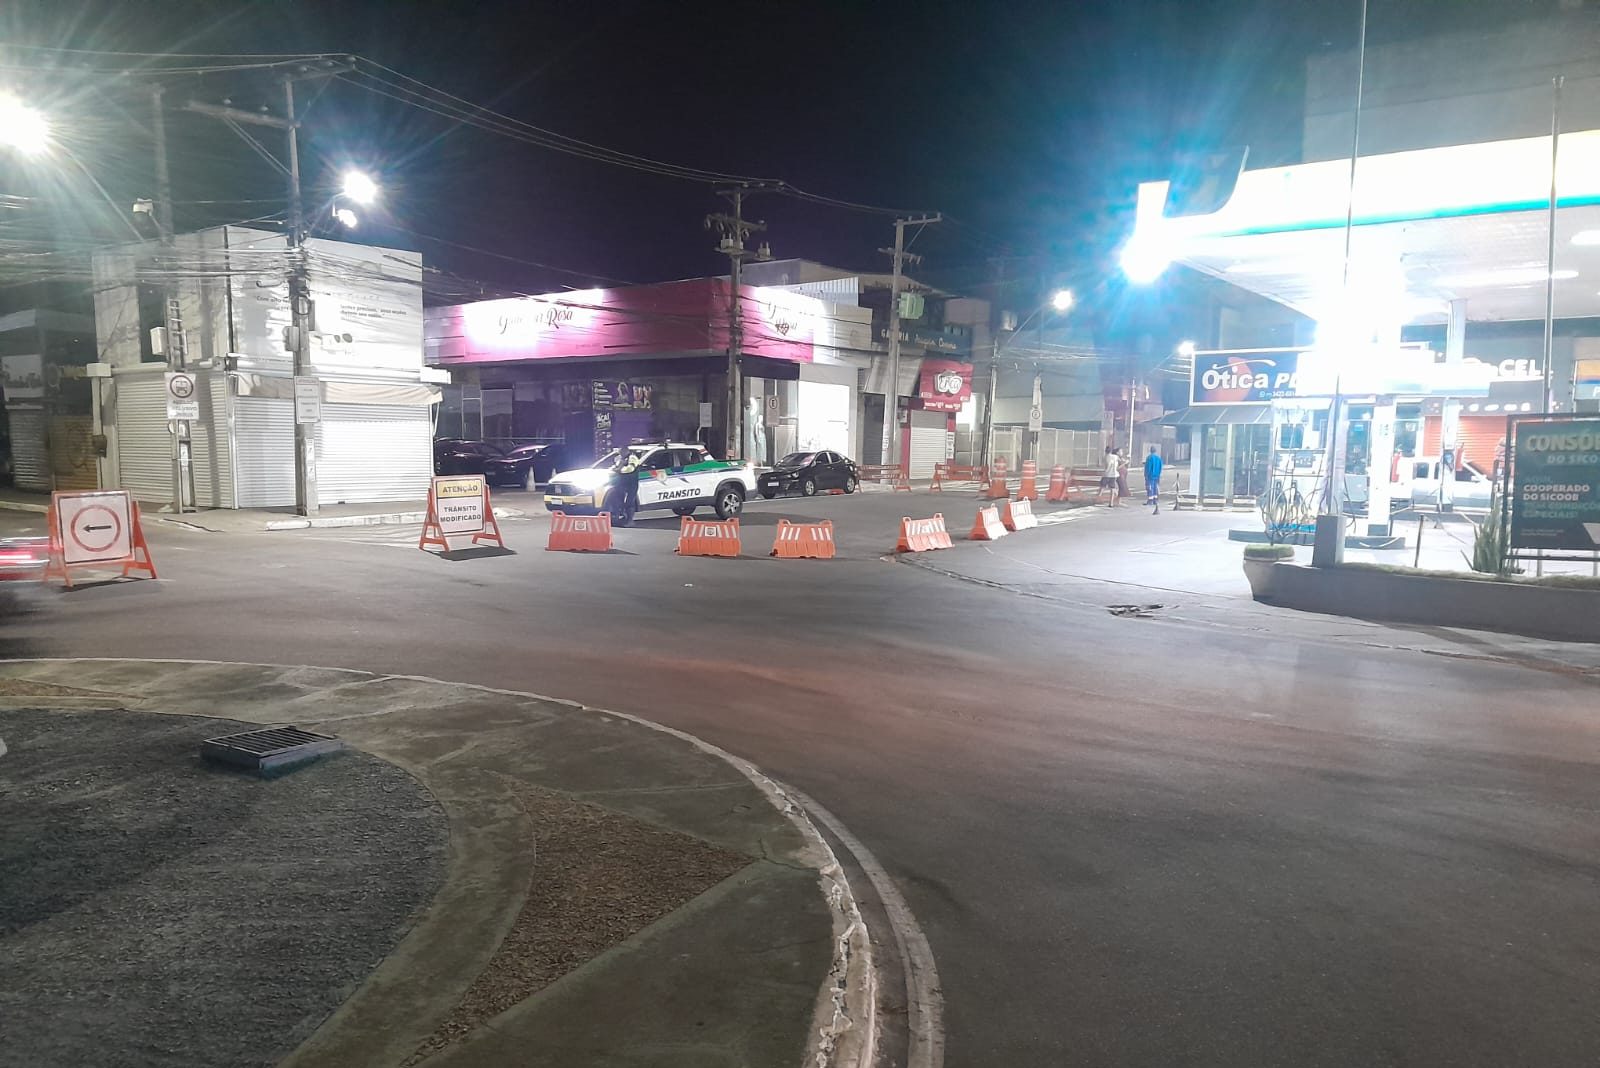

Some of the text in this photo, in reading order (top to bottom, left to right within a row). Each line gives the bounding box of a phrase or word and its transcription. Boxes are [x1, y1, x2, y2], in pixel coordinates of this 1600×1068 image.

[1526, 428, 1600, 452] CONSÓ
[442, 485, 478, 493] ATENÇÃO
[1523, 484, 1591, 493] COOPERADO
[1523, 493, 1580, 501] DO SICOOB
[440, 514, 482, 522] MODIFICADO
